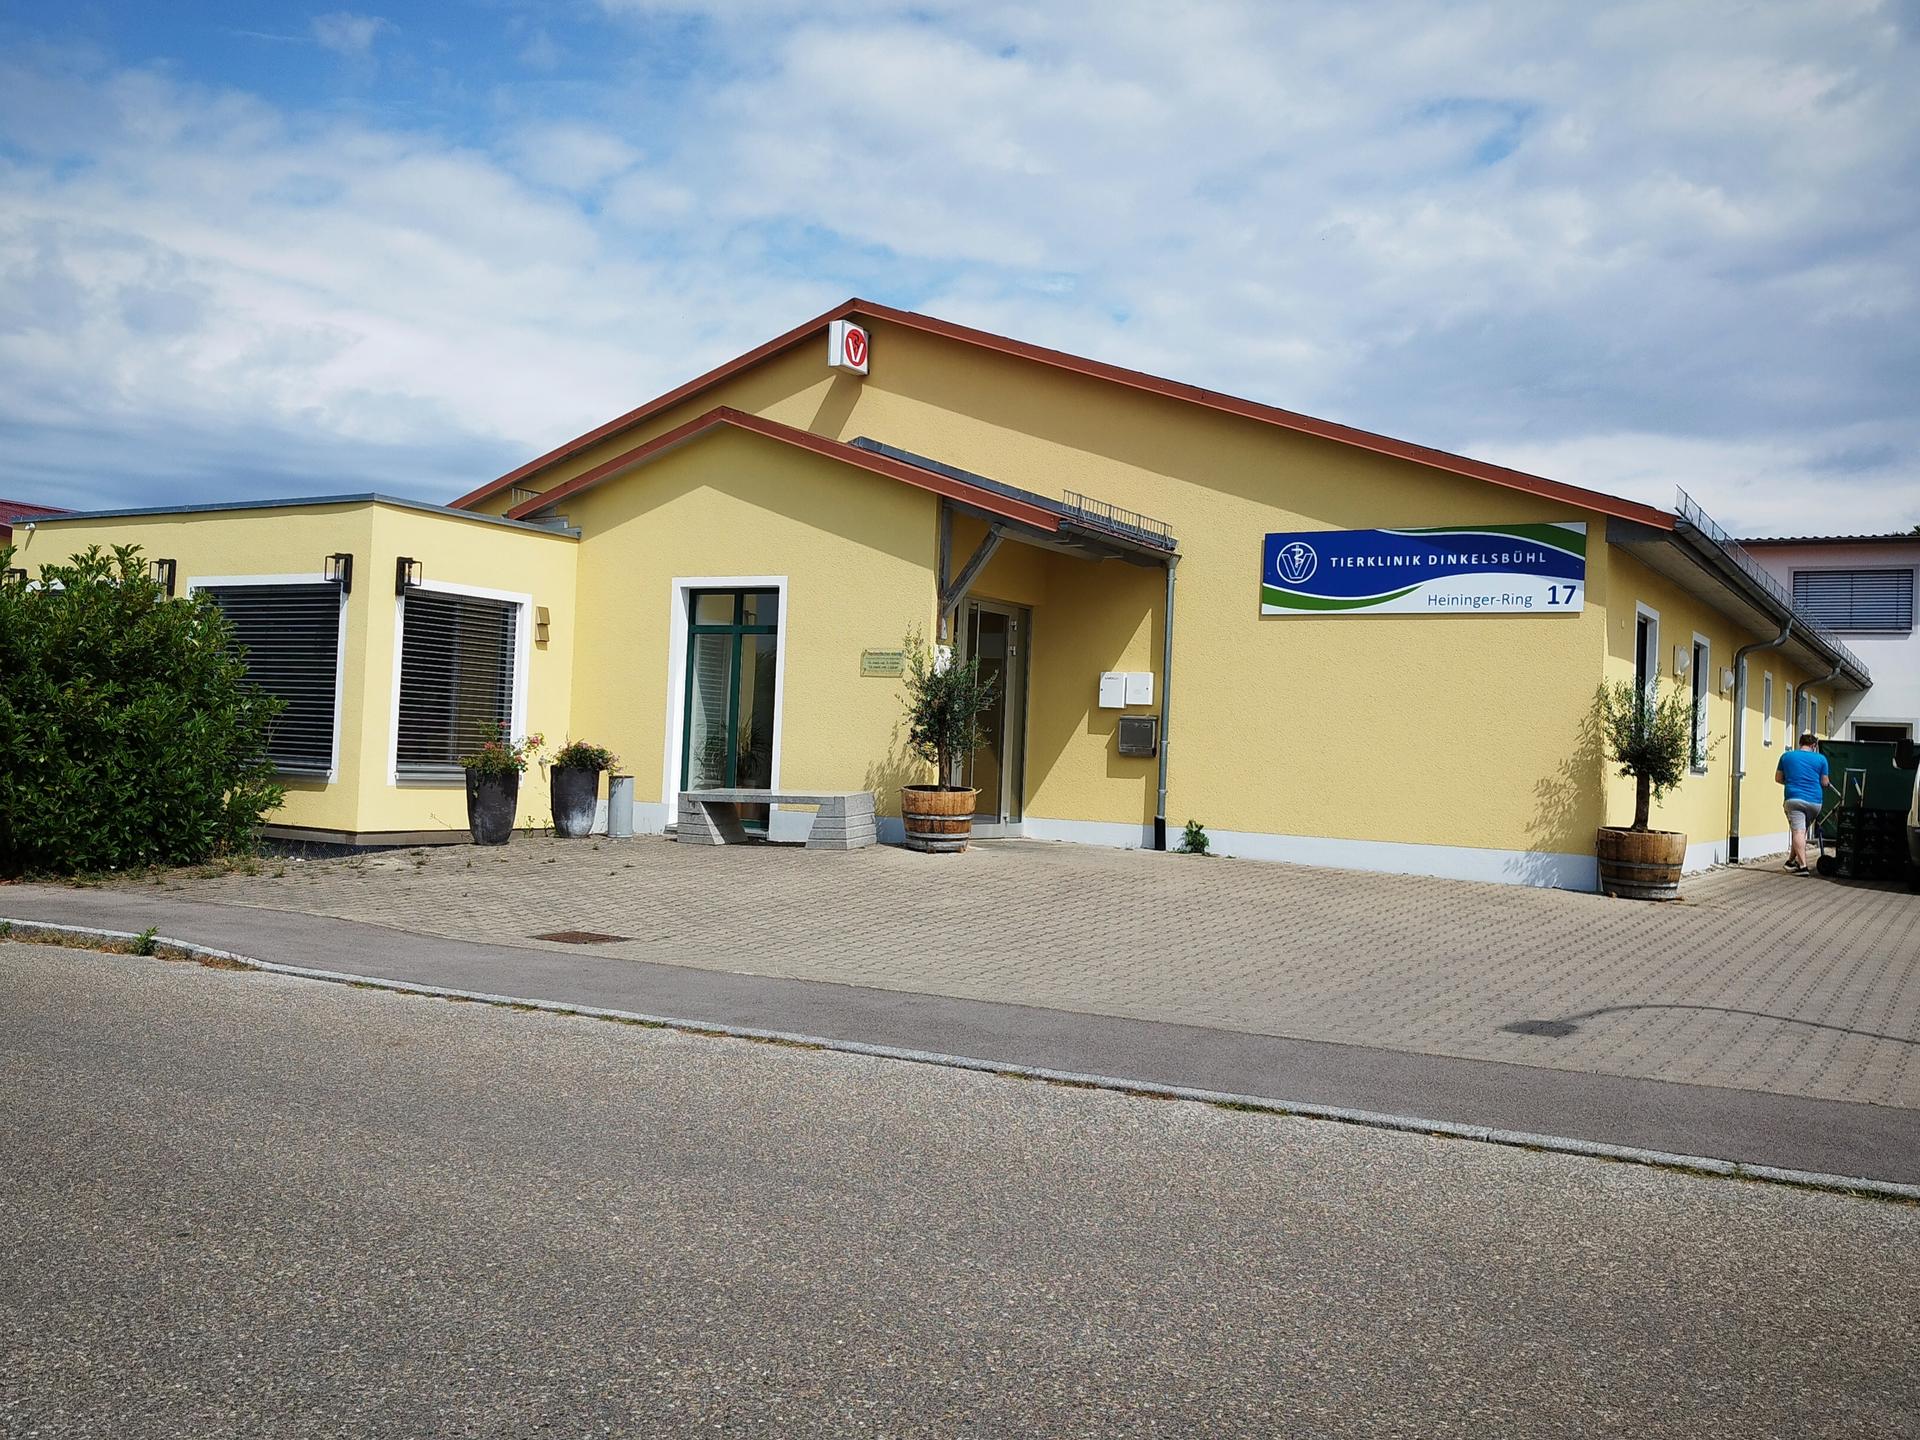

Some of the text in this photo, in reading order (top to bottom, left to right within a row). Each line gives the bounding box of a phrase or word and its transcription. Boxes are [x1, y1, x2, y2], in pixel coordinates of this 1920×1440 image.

[1330, 551, 1546, 568] TIERKLINIK DINKELSBÜHL
[1428, 585, 1577, 609] Heininger-Ring 17
